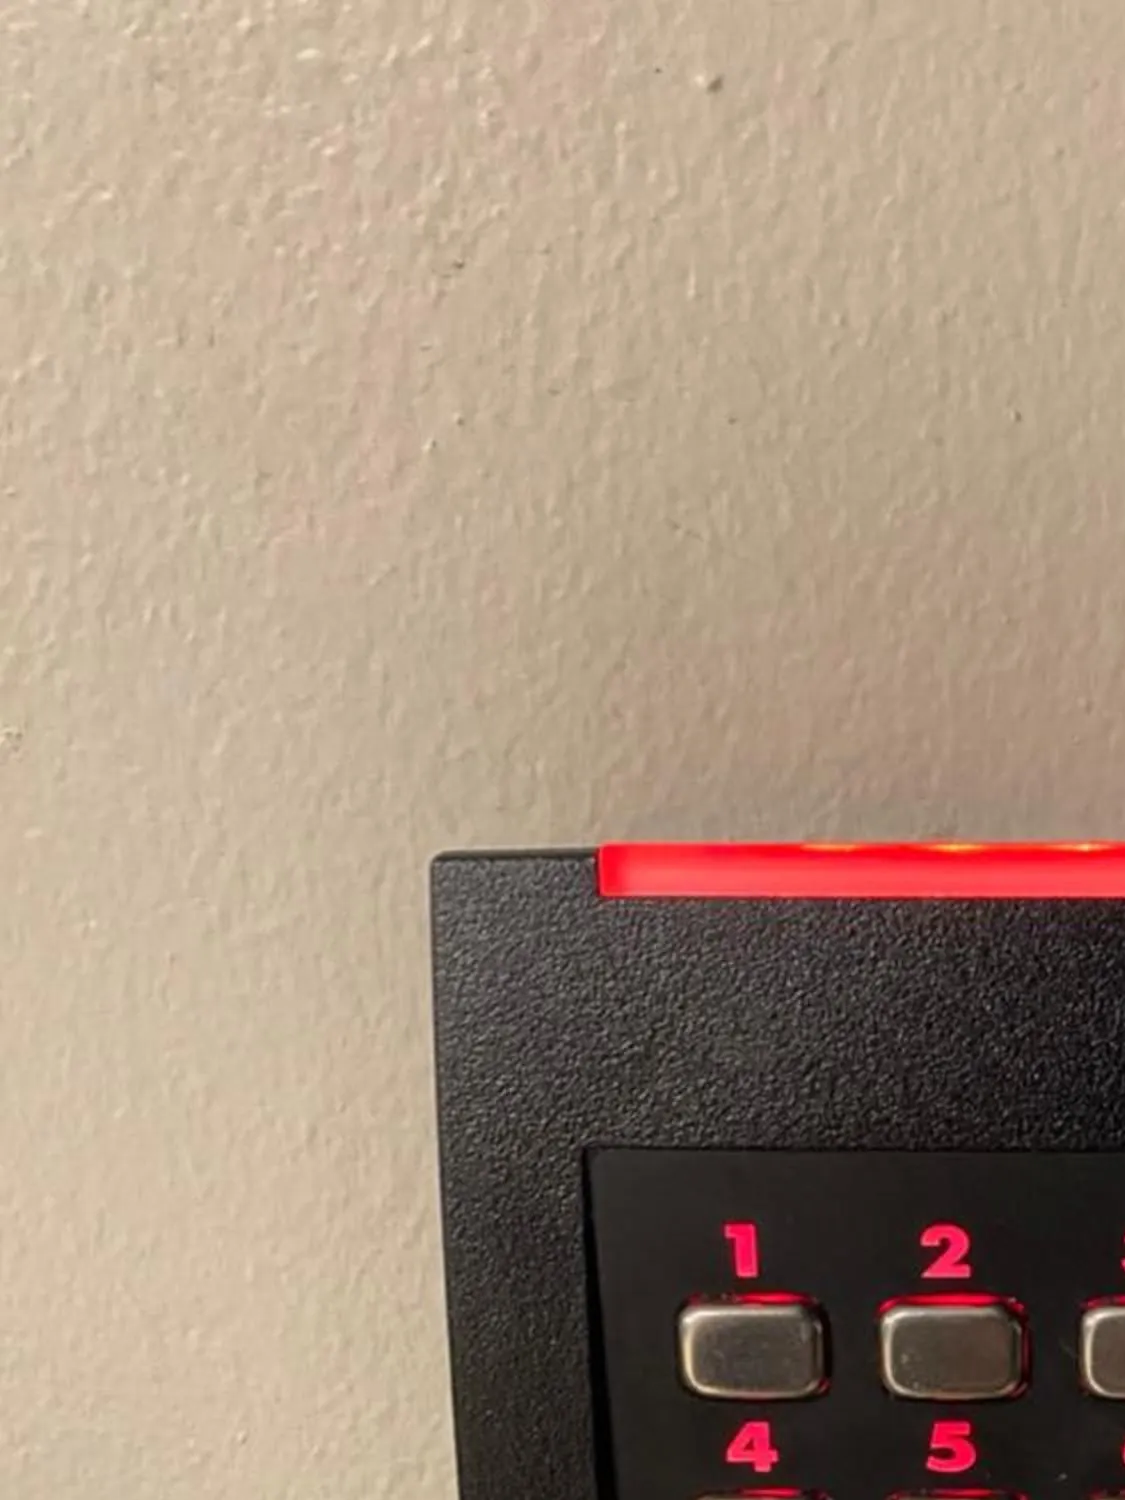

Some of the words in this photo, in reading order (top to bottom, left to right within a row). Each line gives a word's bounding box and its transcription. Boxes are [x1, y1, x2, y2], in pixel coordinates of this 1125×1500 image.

[722, 1221, 760, 1279] 1
[919, 1223, 972, 1279] 2
[724, 1420, 780, 1473] 4
[925, 1419, 977, 1474] 5
